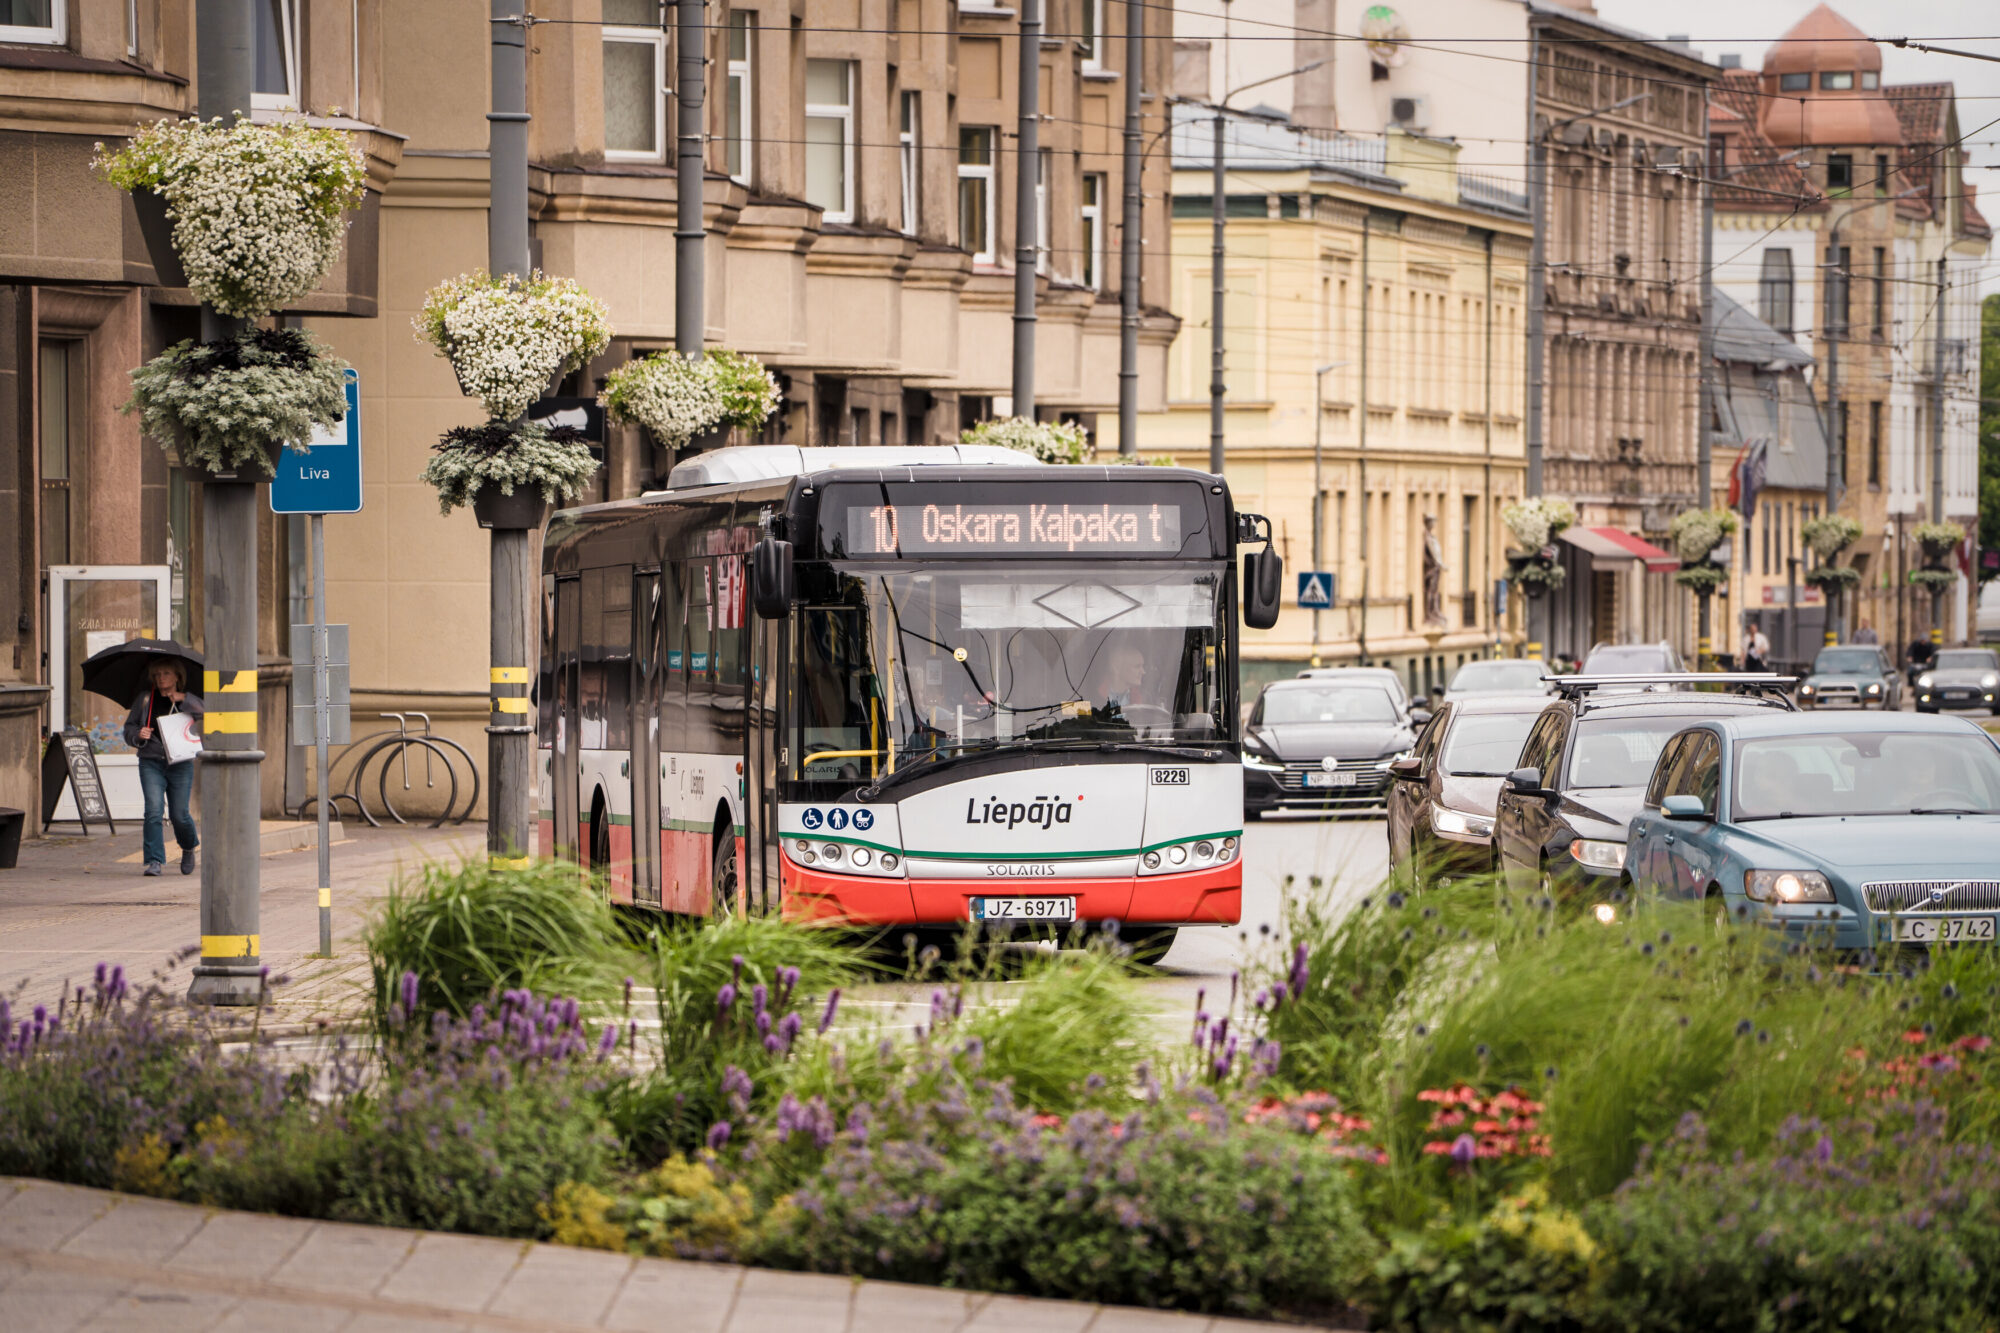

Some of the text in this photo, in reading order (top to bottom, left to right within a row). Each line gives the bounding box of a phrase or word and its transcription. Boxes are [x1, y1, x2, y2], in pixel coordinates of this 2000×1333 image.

[300, 466, 330, 480] Līva
[870, 504, 1161, 552] 10 Oskara Kalpaka t
[803, 766, 841, 774] OLARIS
[1155, 770, 1187, 783] 8229
[966, 795, 1073, 830] Liepāja
[986, 864, 1056, 876] SOLARIS
[989, 901, 1066, 917] JZ-6971
